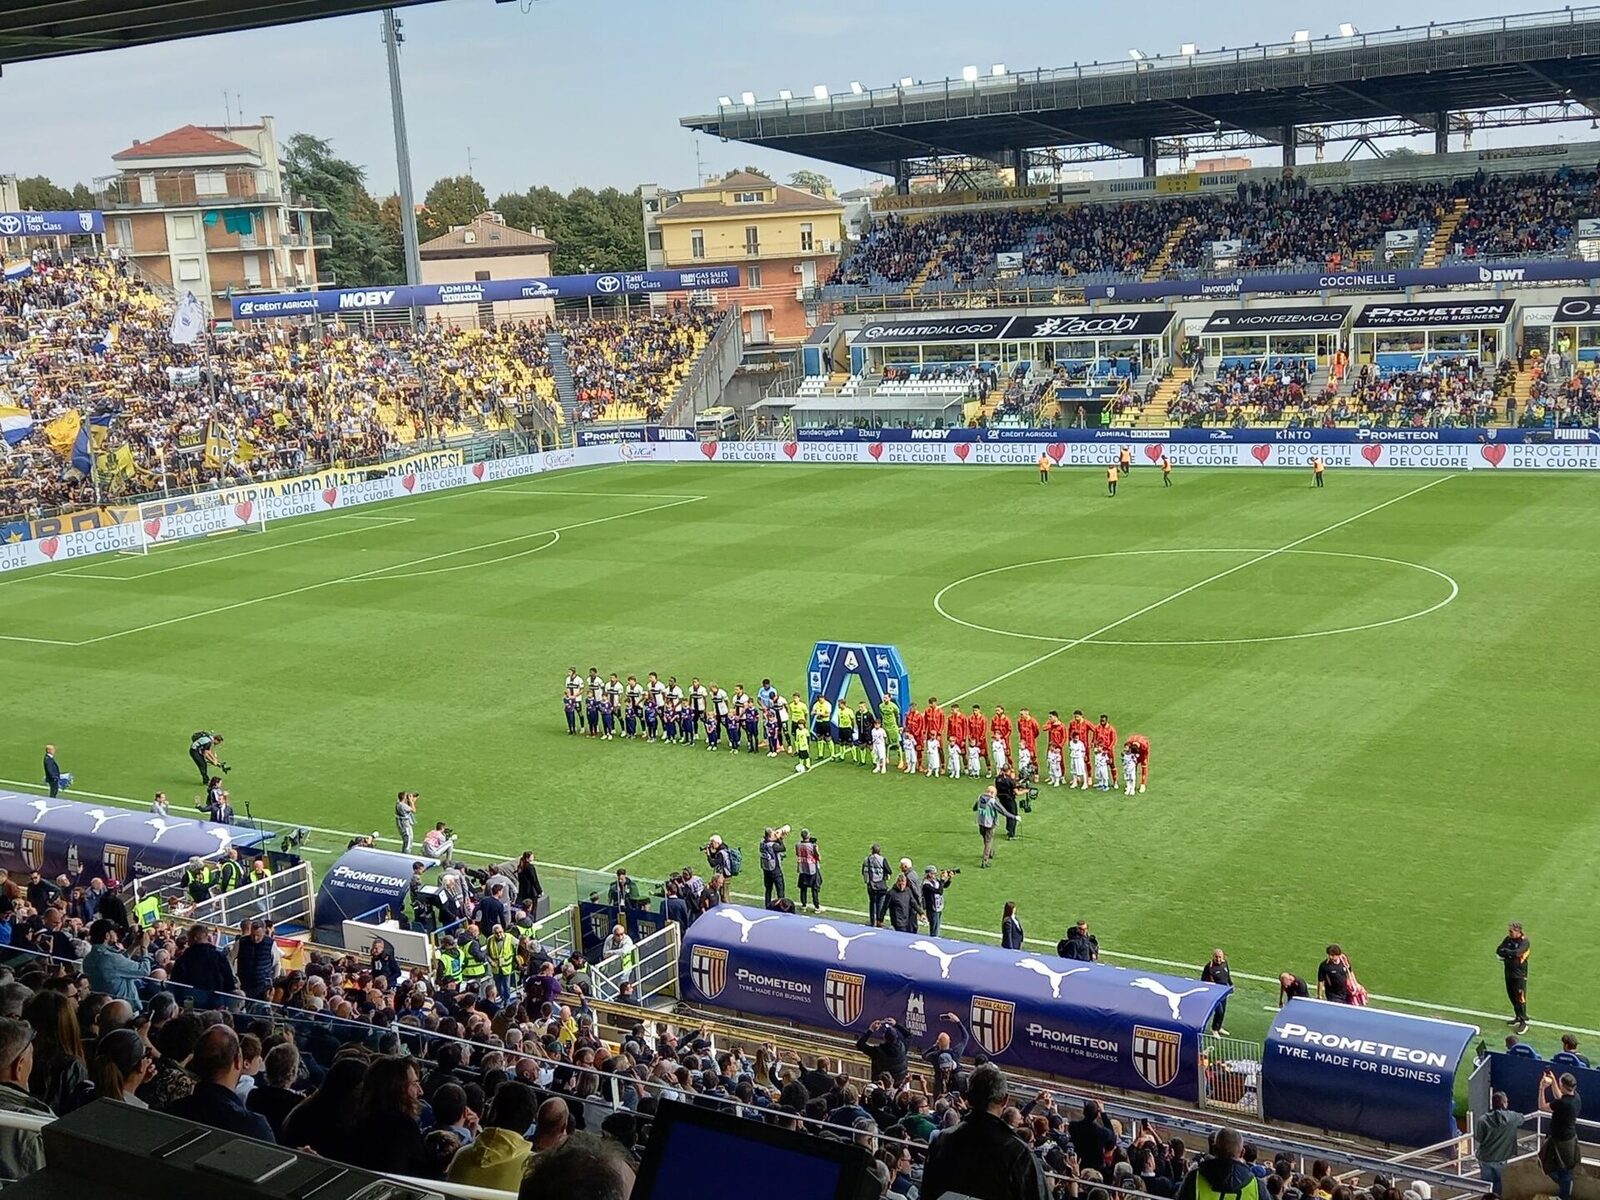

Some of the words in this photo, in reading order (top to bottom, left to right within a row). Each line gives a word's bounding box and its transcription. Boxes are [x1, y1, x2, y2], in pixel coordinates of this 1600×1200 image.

[26, 214, 44, 223] Zatti
[27, 222, 42, 232] Top
[42, 221, 62, 231] Class
[625, 275, 643, 283] Zatti
[1320, 274, 1395, 286] COCCINELLE
[1493, 269, 1525, 281] BWT
[438, 284, 485, 295] ADMIRAL
[626, 281, 641, 290] Top
[642, 280, 661, 289] Class
[282, 299, 319, 310] AGRICOLE
[340, 291, 395, 308] MOBY
[1365, 305, 1504, 318] PROMETEON
[1451, 313, 1500, 321] BUSINESS
[1236, 313, 1343, 325] MONTEZEMOLO
[658, 429, 686, 440] PUMA
[911, 429, 949, 439] MOBY
[1025, 430, 1058, 438] AGRICOLE
[1095, 430, 1130, 438] ADMIRAL
[1356, 429, 1439, 440] PROMETEON
[1554, 429, 1589, 440] PUMA
[722, 443, 777, 452] PROGETTI
[803, 443, 859, 453] PROGETTI
[888, 444, 947, 453] PROGETTI
[976, 444, 1037, 454] PROGETTI
[1169, 445, 1239, 455] PROGETTI
[1277, 445, 1352, 456] PROGETTI
[1389, 446, 1469, 456] PROGETTI
[1513, 446, 1598, 457] PROGETTI
[722, 451, 740, 461] DEL
[742, 451, 777, 461] CUORE
[803, 452, 822, 461] DEL
[824, 452, 859, 461] CUORE
[889, 453, 908, 462] DEL
[911, 453, 947, 462] CUORE
[976, 454, 996, 463] DEL
[999, 454, 1037, 463] CUORE
[1071, 454, 1093, 464] DEL
[1196, 455, 1239, 465] CUORE
[1278, 456, 1301, 466] DEL
[489, 456, 534, 470] PROGETTI
[1389, 457, 1418, 466] DEL
[1421, 457, 1468, 467] CUORE
[1514, 458, 1541, 468] DEL
[1546, 458, 1598, 468] CUORE
[420, 466, 467, 482] PROGETTI
[489, 469, 506, 480] DEL
[507, 465, 534, 477] CUORE
[342, 479, 394, 495] PROGETTI
[421, 481, 438, 492] DEL
[438, 476, 468, 488] CUORE
[343, 494, 361, 506] DEL
[361, 489, 394, 502] CUORE
[281, 503, 316, 517] CUORE
[166, 508, 227, 528] PROGETTI
[66, 524, 136, 545] PROGETTI
[167, 526, 192, 539] DEL
[192, 519, 227, 534] CUORE
[66, 544, 91, 557] DEL
[94, 536, 136, 552] CUORE
[333, 866, 407, 888] PROMETEON
[734, 968, 812, 994] PROMETEON
[1025, 1023, 1119, 1053] PROMETEON
[1274, 1022, 1447, 1068] PROMETEON
[1050, 1044, 1070, 1055] MADE
[1070, 1047, 1085, 1057] FOR
[1085, 1050, 1119, 1064] BUSINESS
[1277, 1044, 1311, 1062] TYRE.
[1314, 1051, 1350, 1068] MADE
[1352, 1058, 1378, 1073] FOR
[1380, 1063, 1442, 1085] BUSINESS
